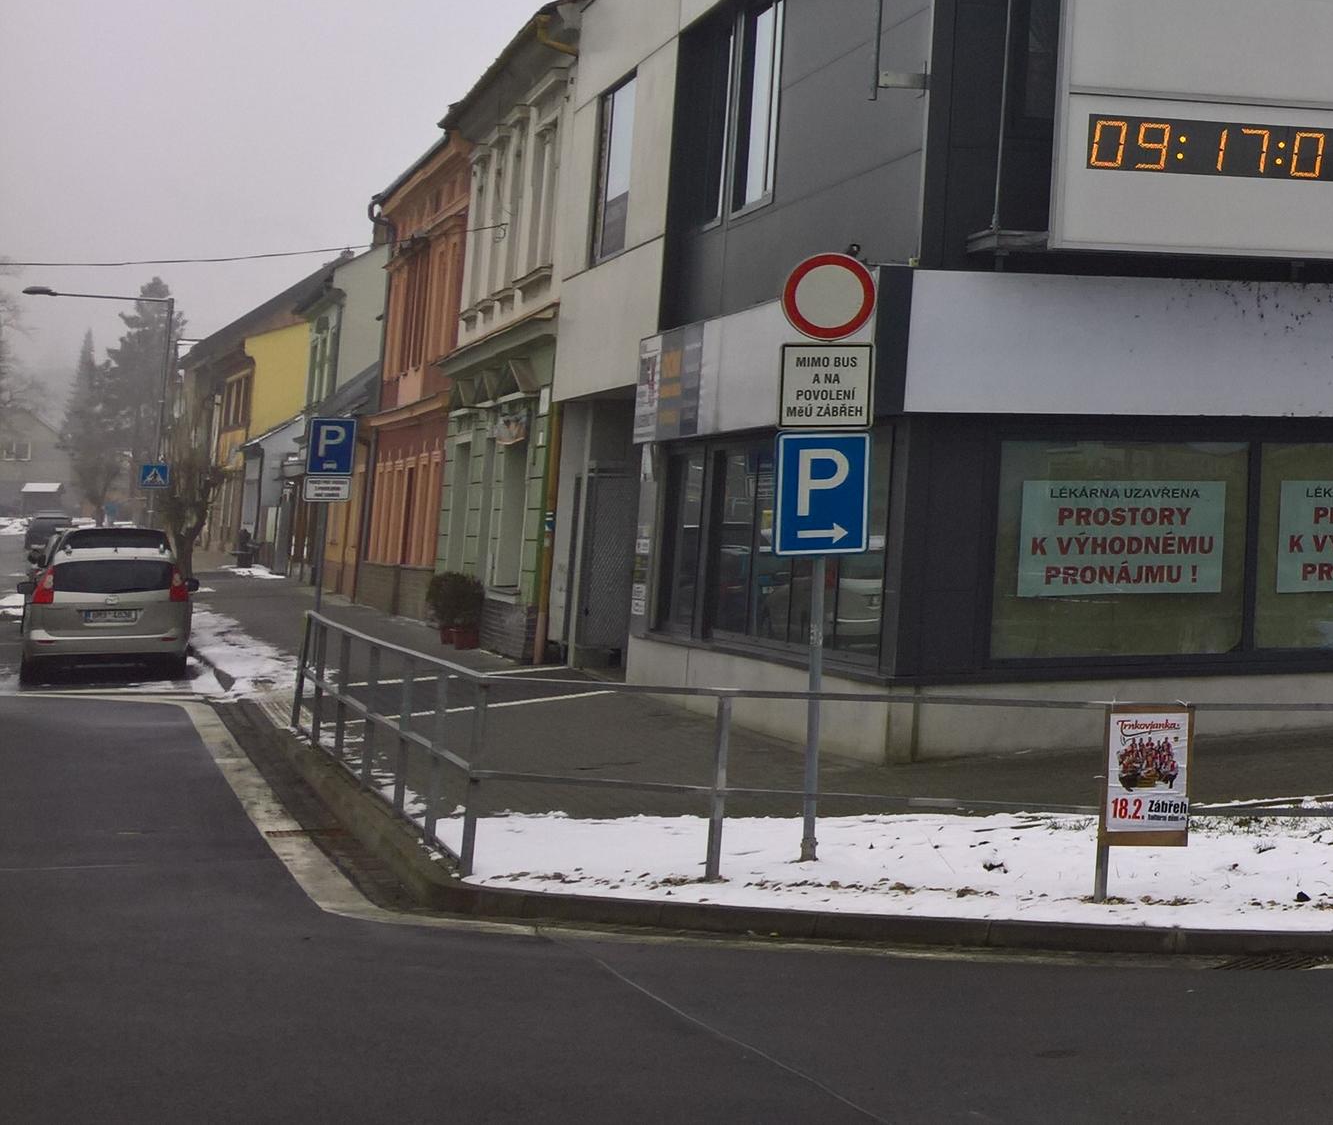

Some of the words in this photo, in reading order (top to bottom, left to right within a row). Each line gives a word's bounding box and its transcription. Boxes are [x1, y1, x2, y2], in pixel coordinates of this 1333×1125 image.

[795, 356, 830, 368] MIMO
[834, 356, 858, 368] BUS
[812, 373, 821, 384] A
[824, 373, 840, 384] NA
[796, 387, 857, 401] POVOLENÍ
[816, 403, 863, 418] ZÁBŘEH
[318, 425, 346, 457] P
[797, 448, 850, 516] P
[1050, 486, 1119, 499] LÉKÁRNA
[1124, 486, 1200, 499] UZAVŘENA
[1057, 507, 1192, 526] PROSTORY
[1031, 536, 1047, 556] K
[1056, 530, 1214, 556] VÝHODNÉMU
[1288, 534, 1303, 553] K
[1044, 560, 1182, 585] PRONÁJMU
[1111, 797, 1145, 820] 18.2.
[1148, 799, 1187, 814] Zábřeh
